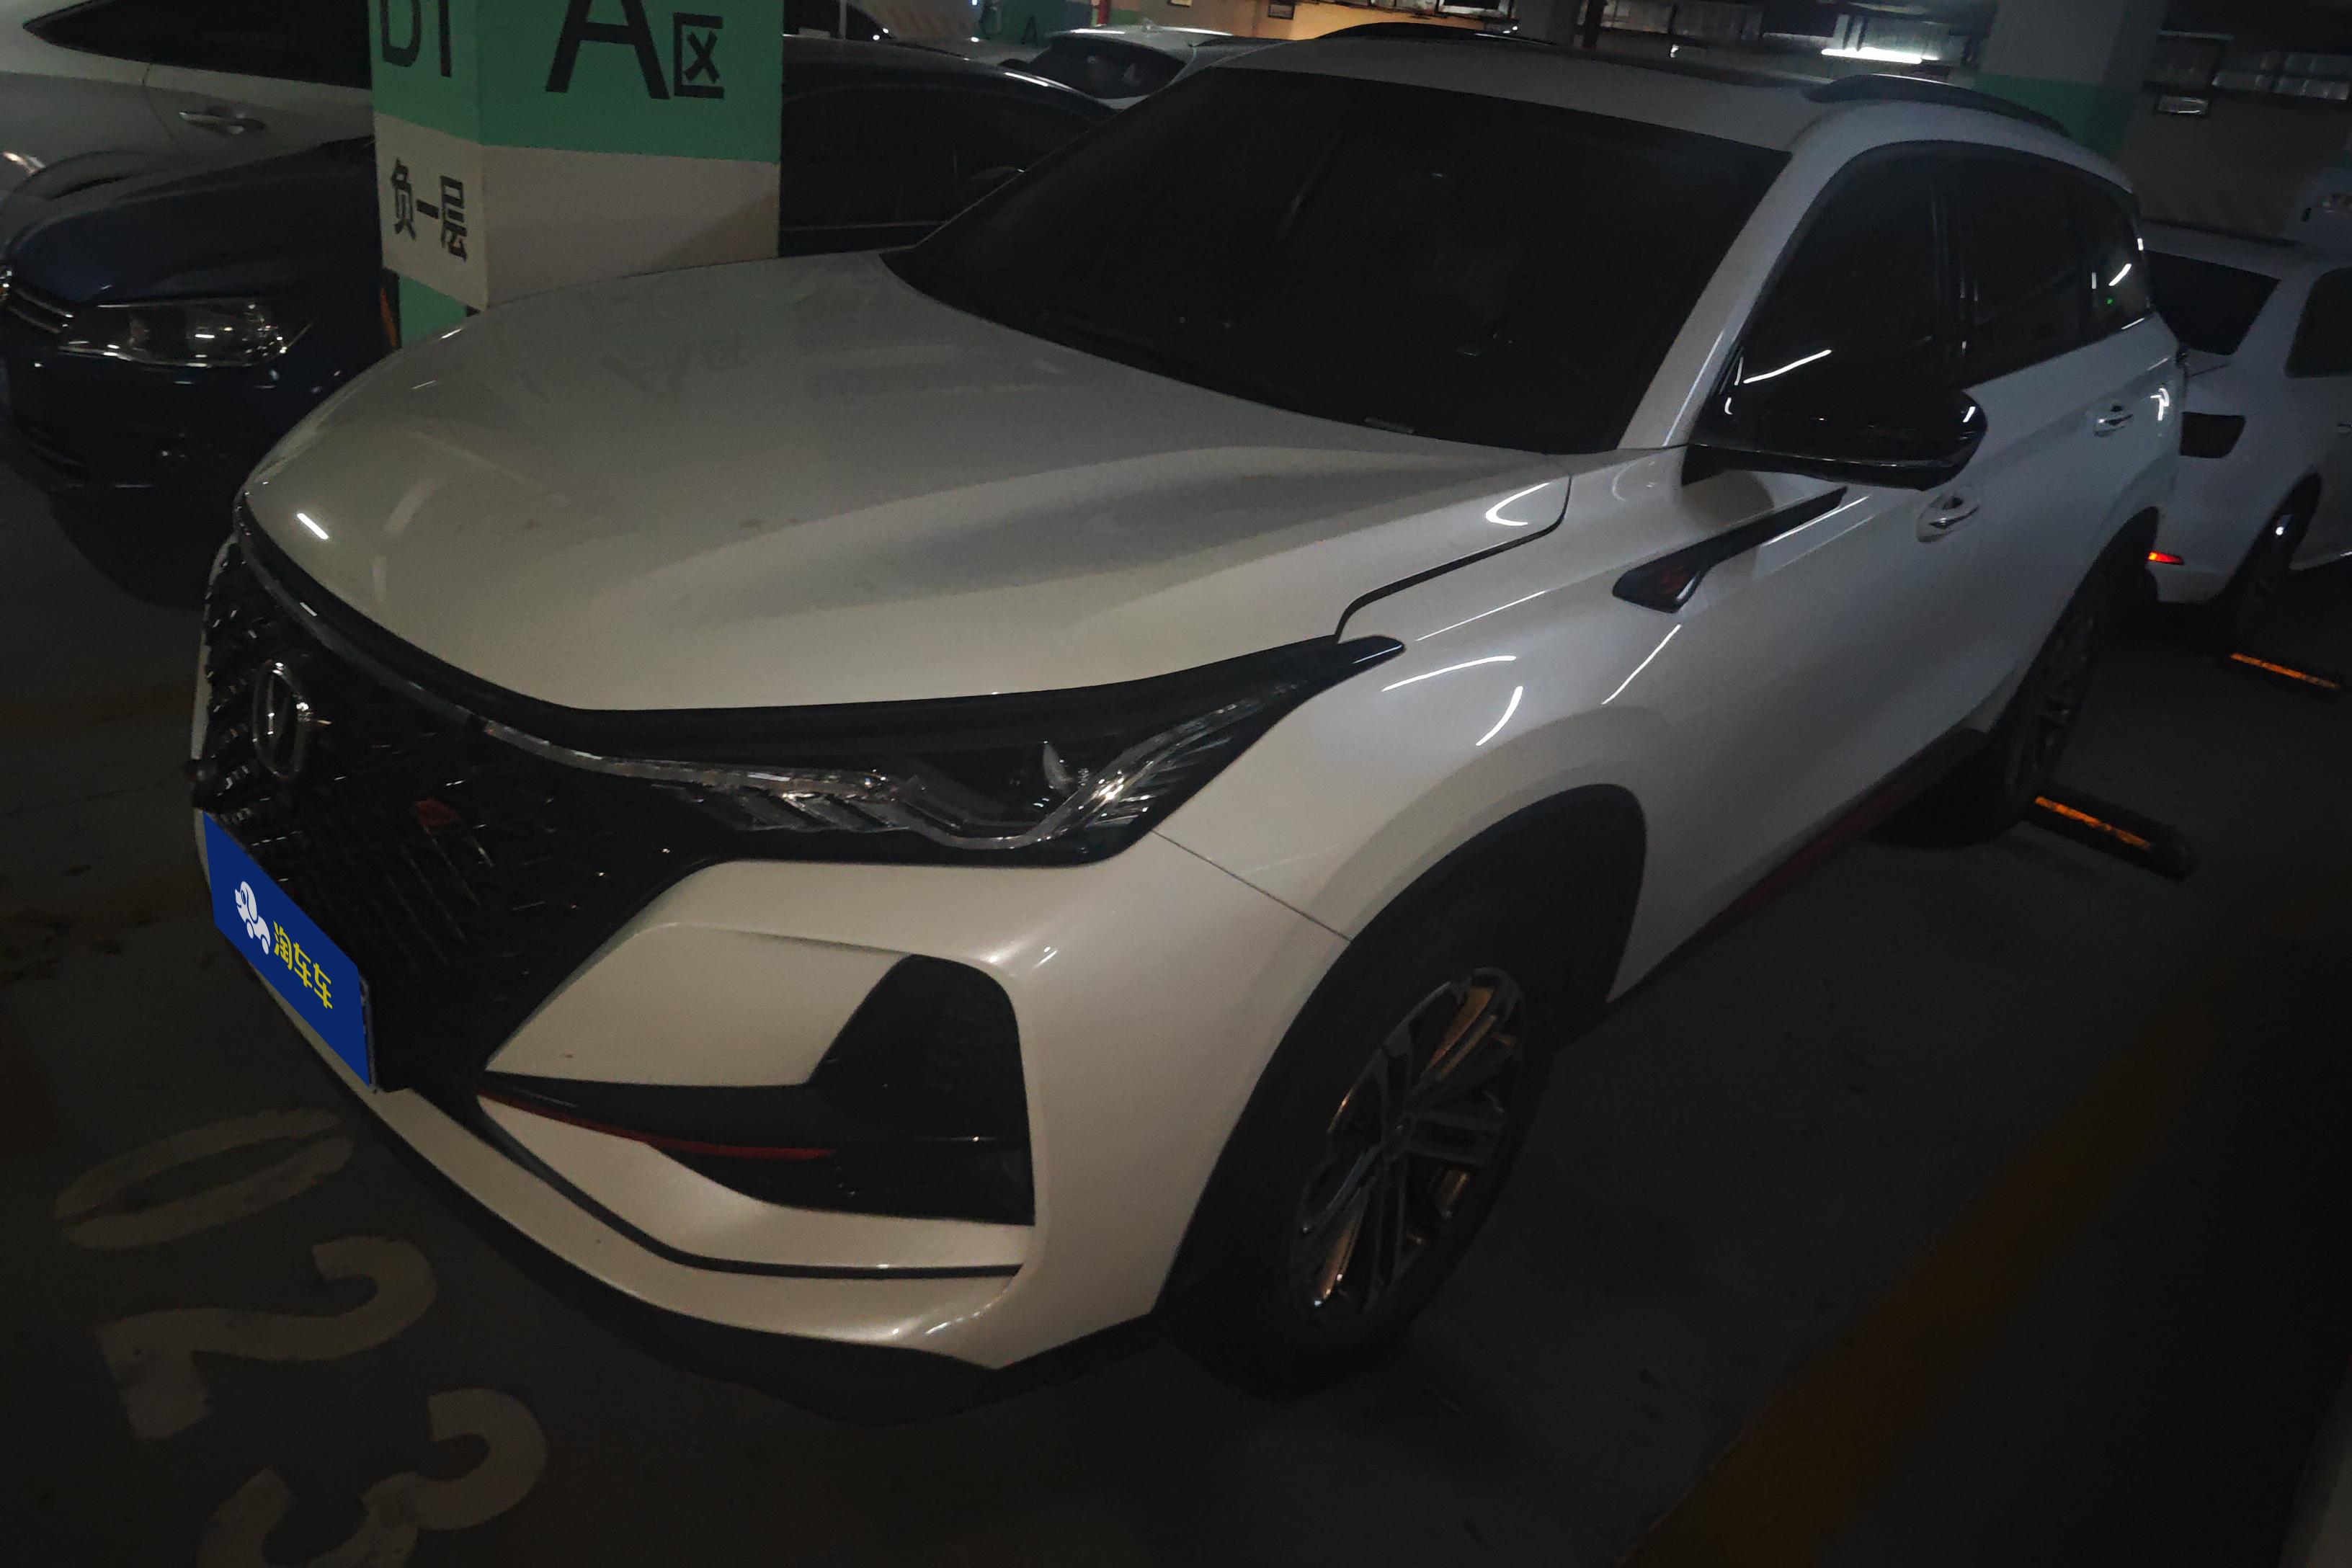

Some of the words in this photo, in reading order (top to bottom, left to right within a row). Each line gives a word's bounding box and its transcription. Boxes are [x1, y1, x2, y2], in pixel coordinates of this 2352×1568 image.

[545, 0, 724, 99] A区
[391, 157, 467, 262] 负一层
[54, 1108, 548, 1568] 023
